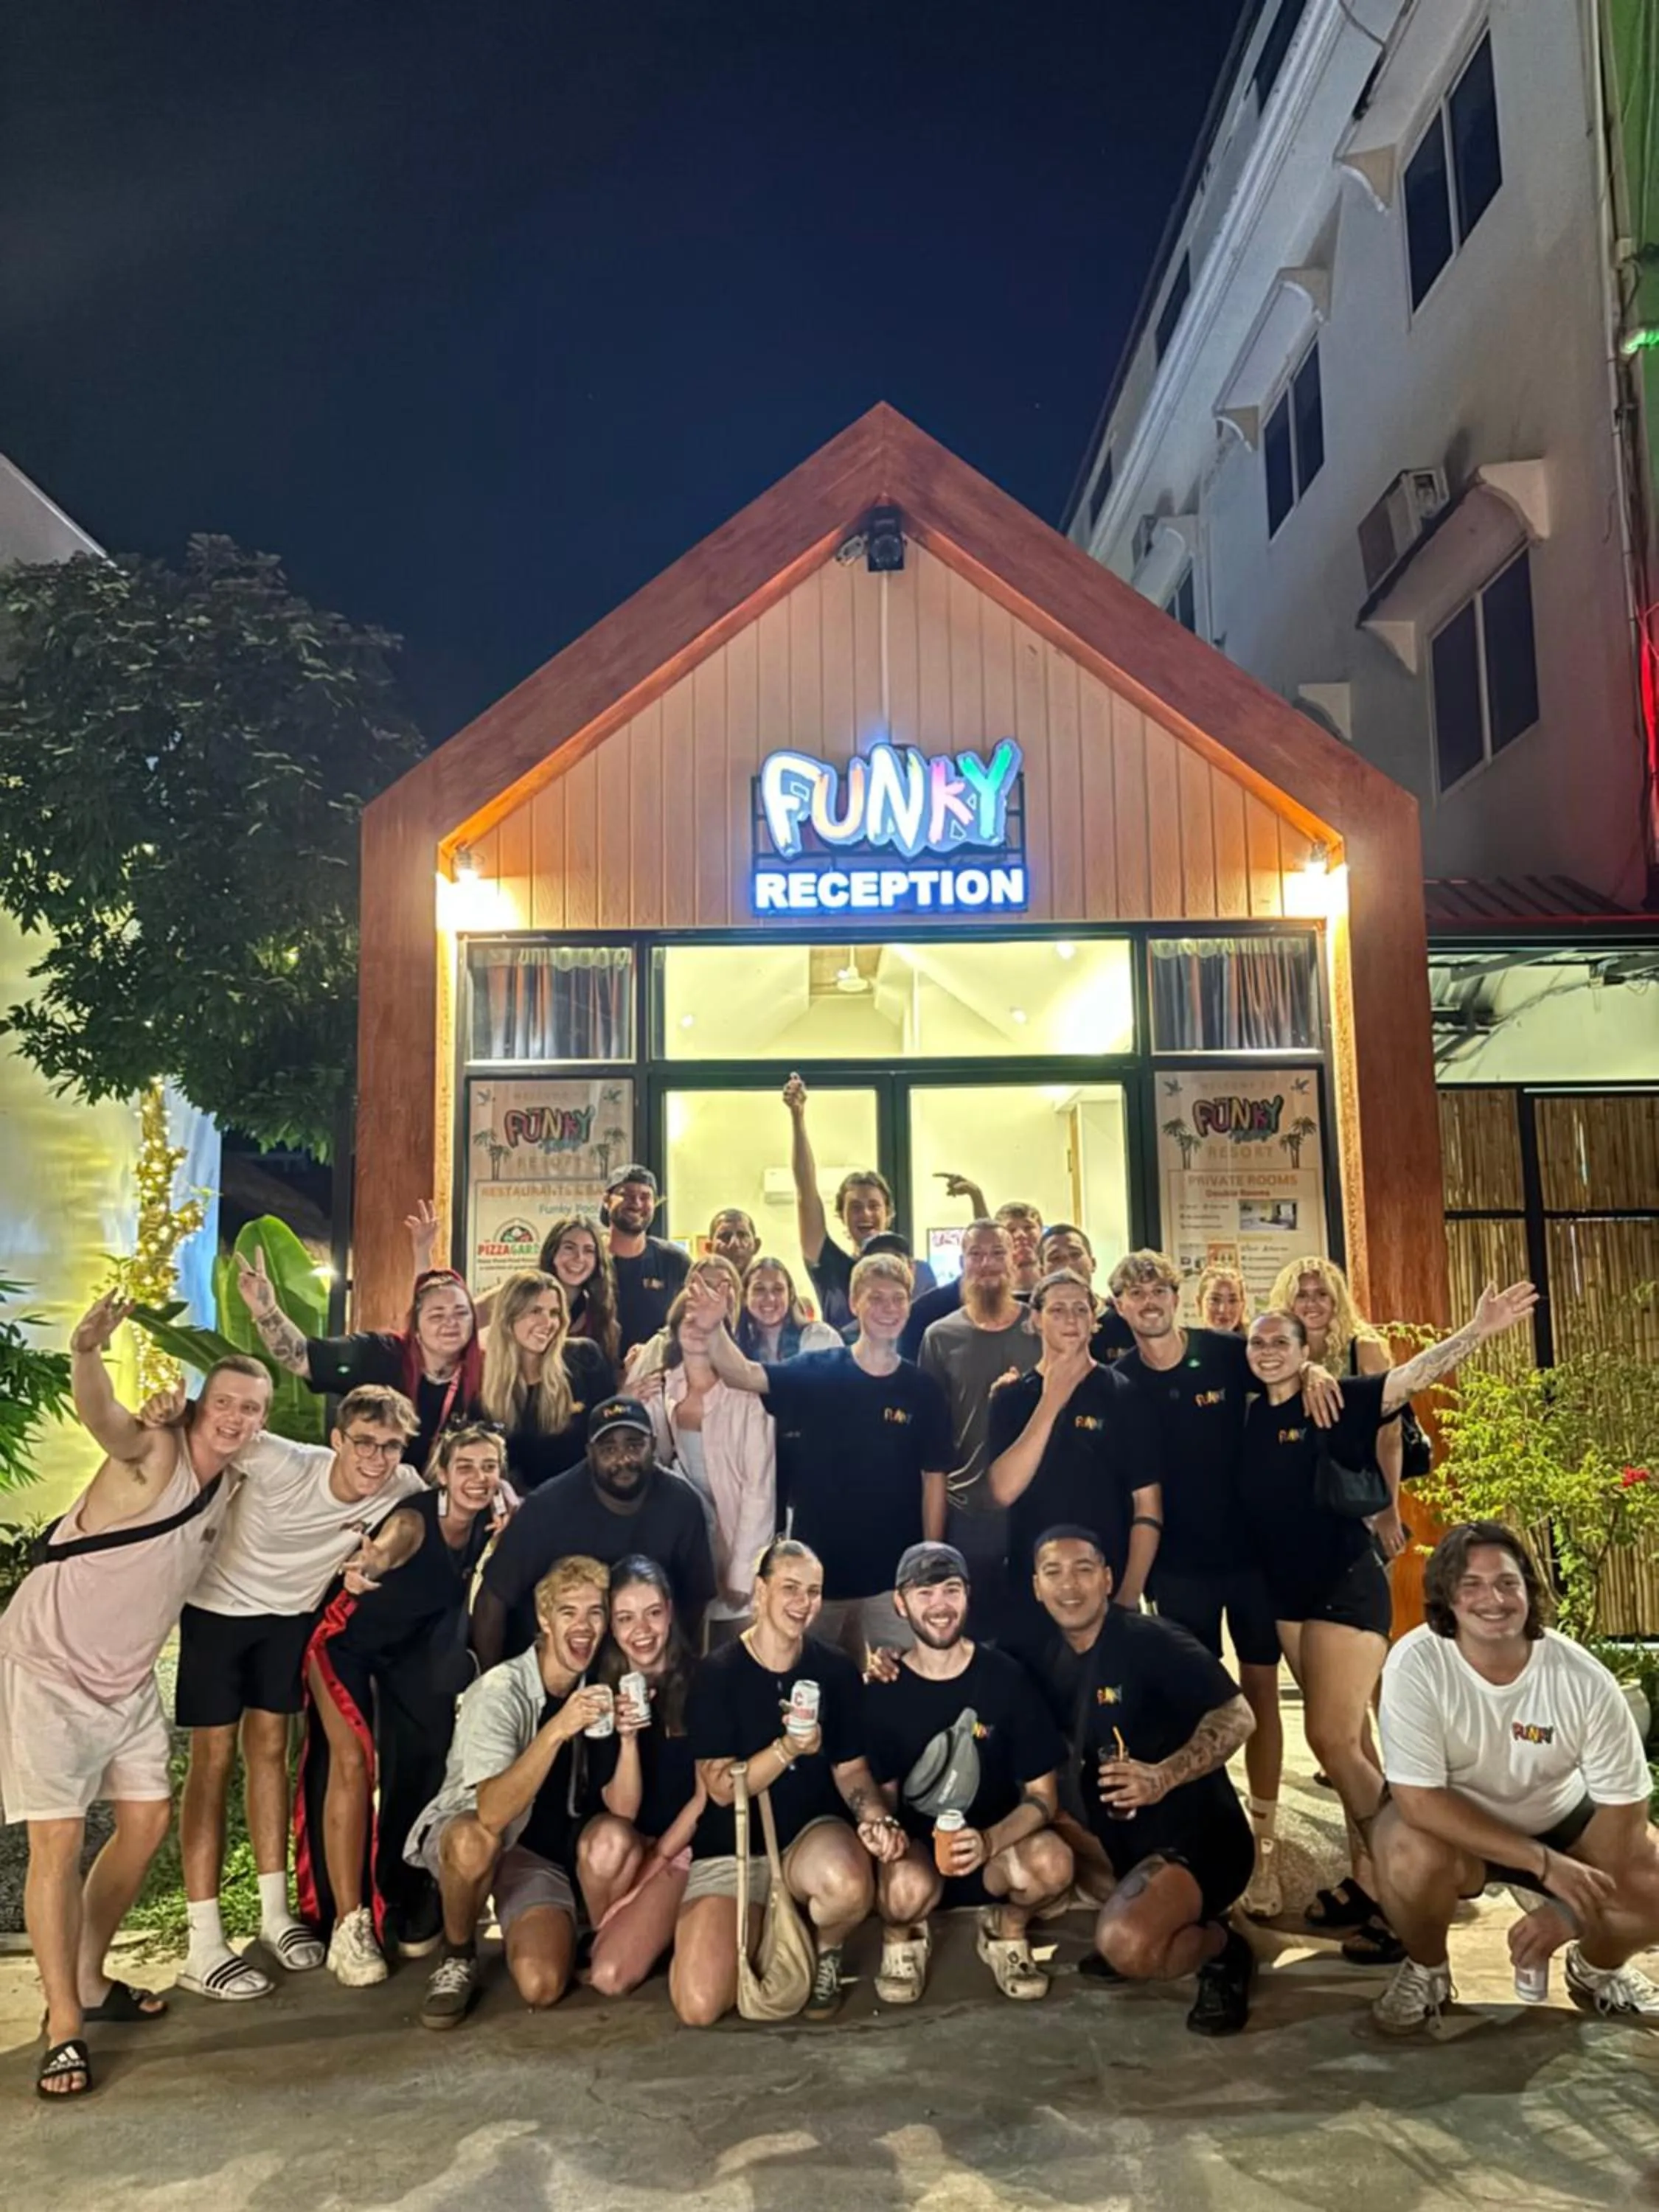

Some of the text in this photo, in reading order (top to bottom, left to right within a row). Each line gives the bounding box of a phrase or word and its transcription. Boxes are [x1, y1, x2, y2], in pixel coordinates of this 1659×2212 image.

[763, 740, 1020, 855] FUNKY
[755, 869, 1023, 908] RECEPTION
[504, 1105, 595, 1148] FUNKY
[1192, 1094, 1284, 1138] FUNKY
[1208, 1145, 1273, 1158] RESORT
[1188, 1174, 1298, 1186] PRIVATE ROOMS
